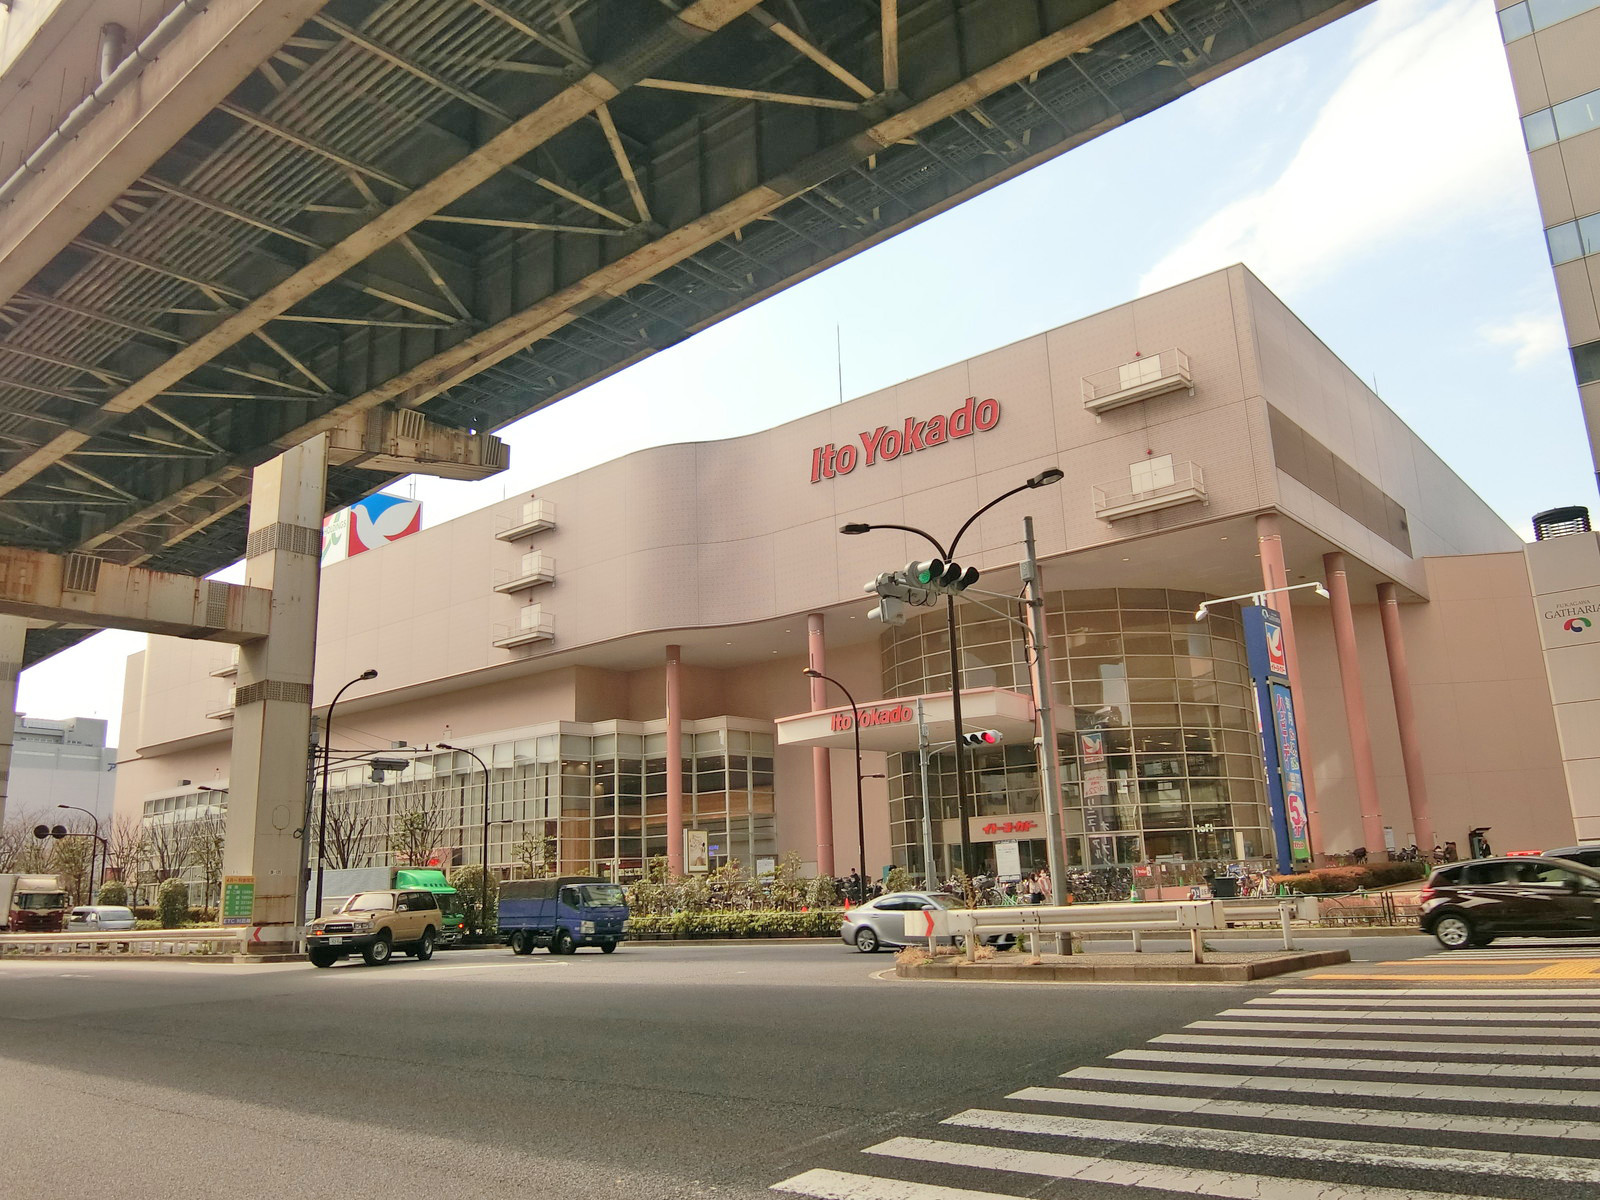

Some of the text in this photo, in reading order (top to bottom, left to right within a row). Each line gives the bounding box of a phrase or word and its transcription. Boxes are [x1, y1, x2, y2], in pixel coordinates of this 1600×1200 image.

[810, 396, 1001, 484] Ito Yokado
[831, 713, 852, 731] Ito
